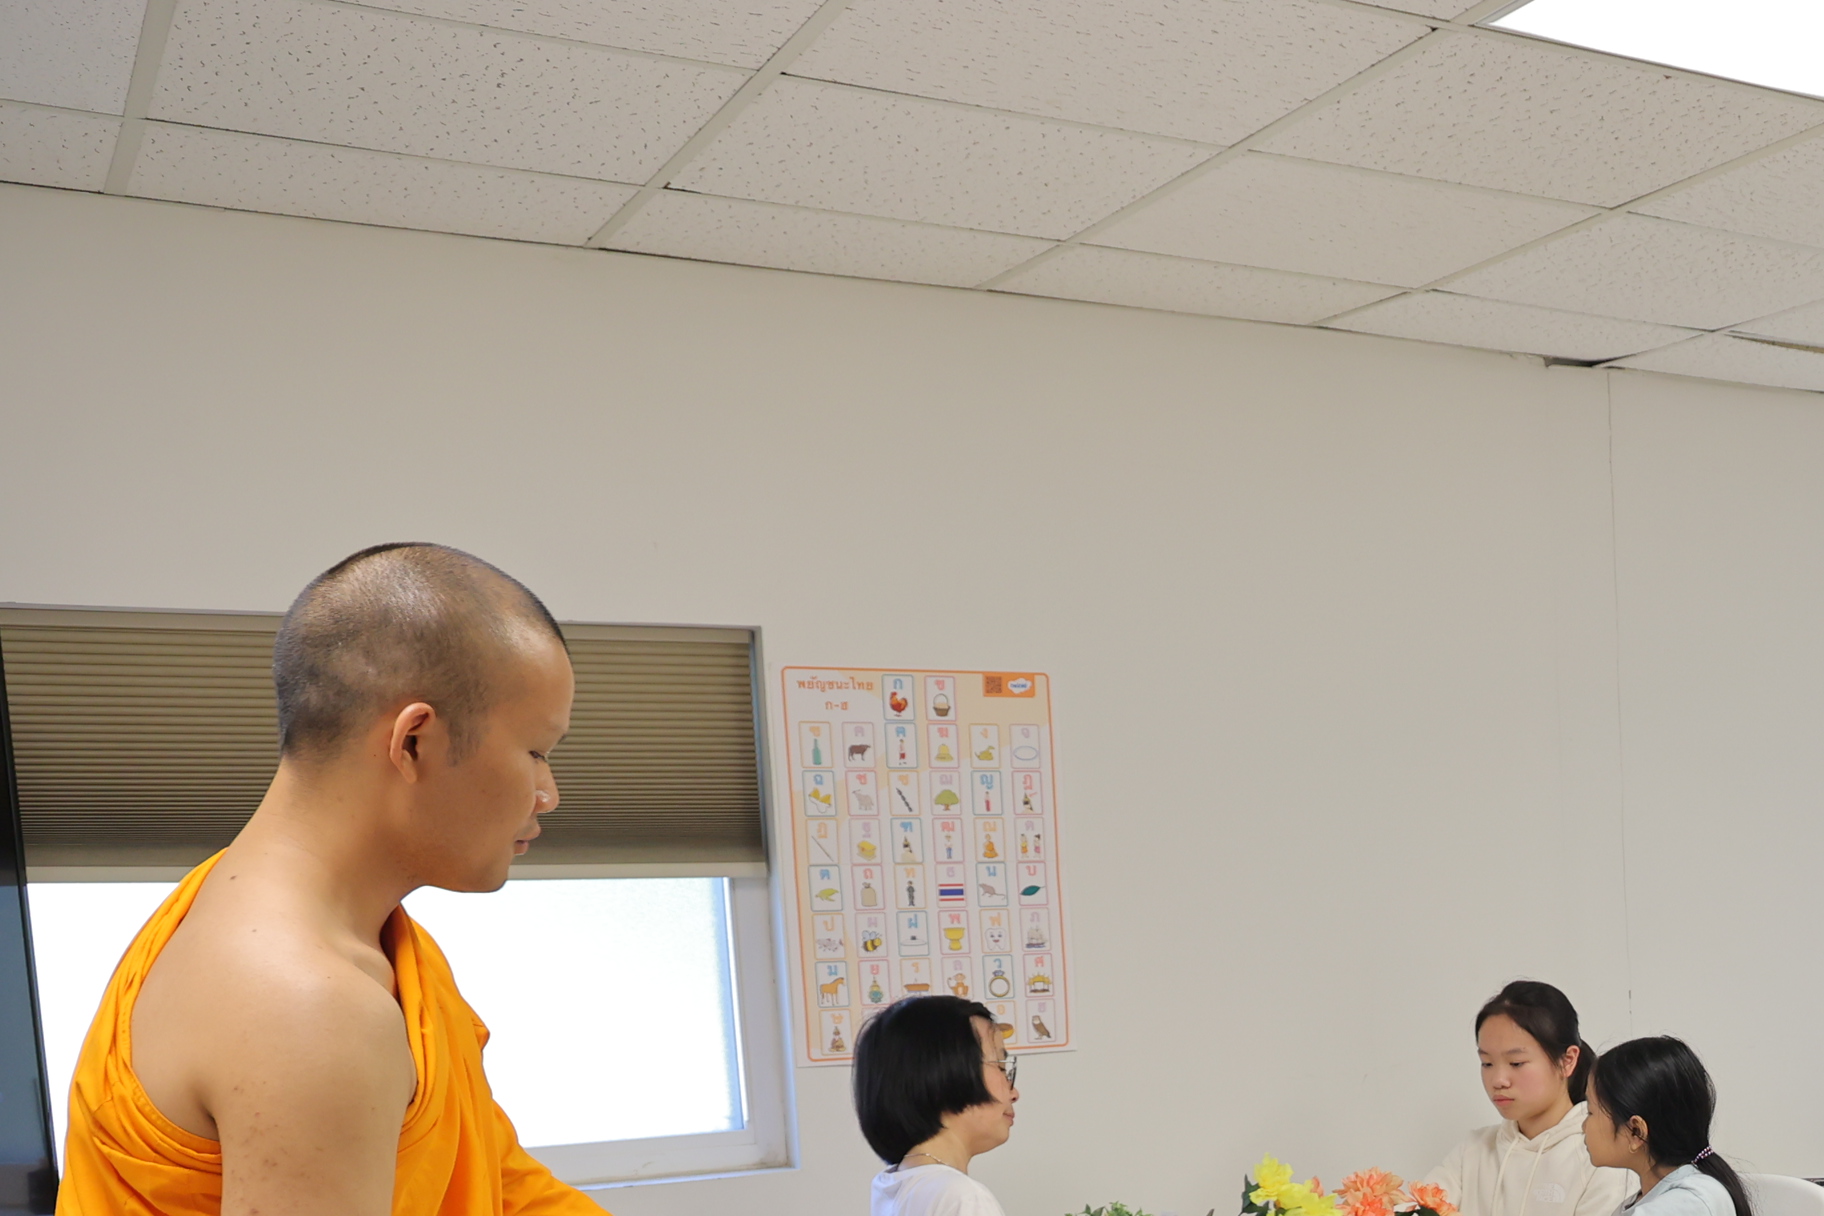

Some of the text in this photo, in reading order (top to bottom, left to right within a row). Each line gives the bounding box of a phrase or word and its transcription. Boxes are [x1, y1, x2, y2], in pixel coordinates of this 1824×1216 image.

[797, 675, 874, 692] พยัญชนะไทย
[893, 678, 903, 690] ก
